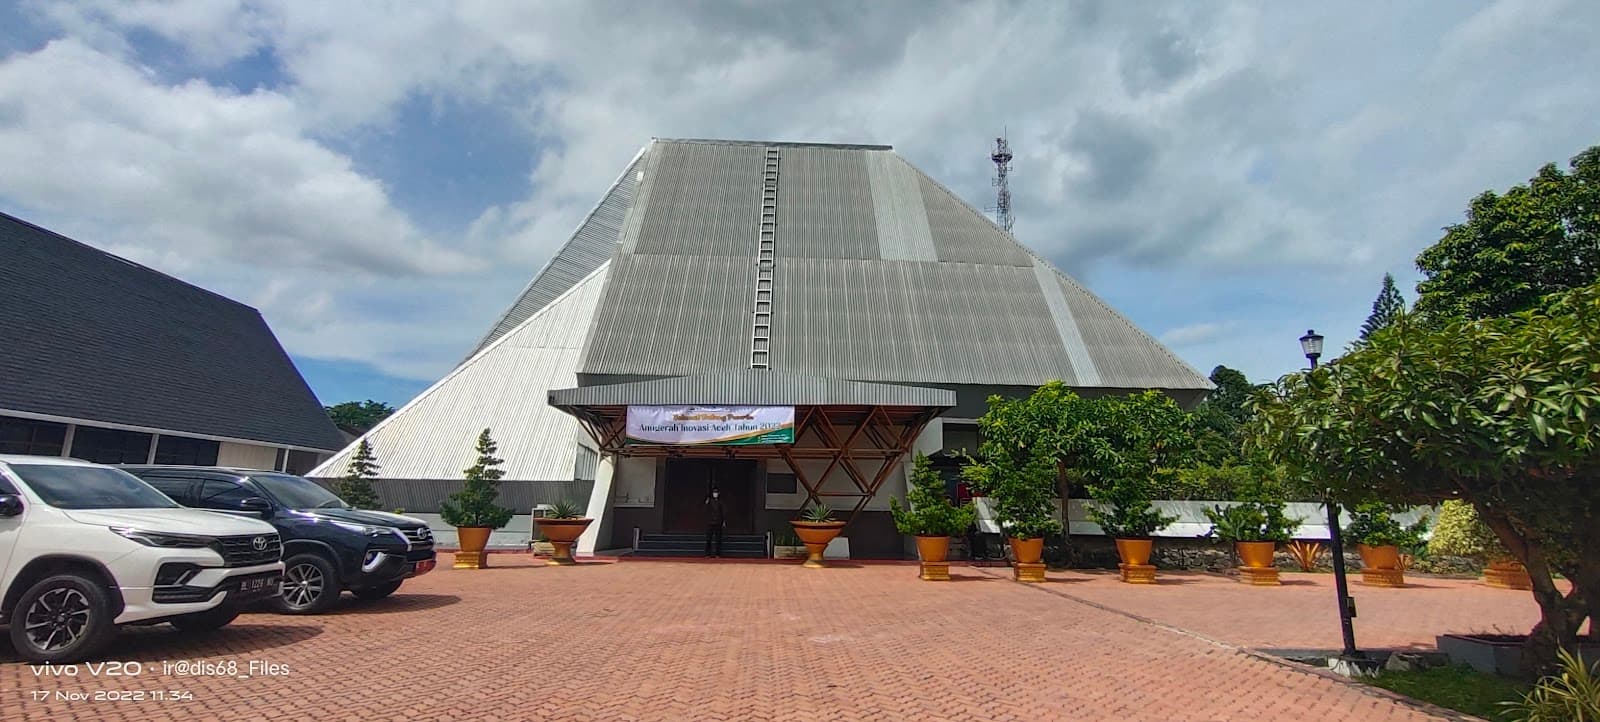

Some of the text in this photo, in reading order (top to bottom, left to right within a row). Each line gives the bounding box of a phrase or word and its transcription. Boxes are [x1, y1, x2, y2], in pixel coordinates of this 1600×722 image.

[639, 423, 679, 433] Anugerah
[680, 423, 709, 432] Inovasi
[710, 423, 731, 432] Aceh
[733, 423, 758, 432] Tahun
